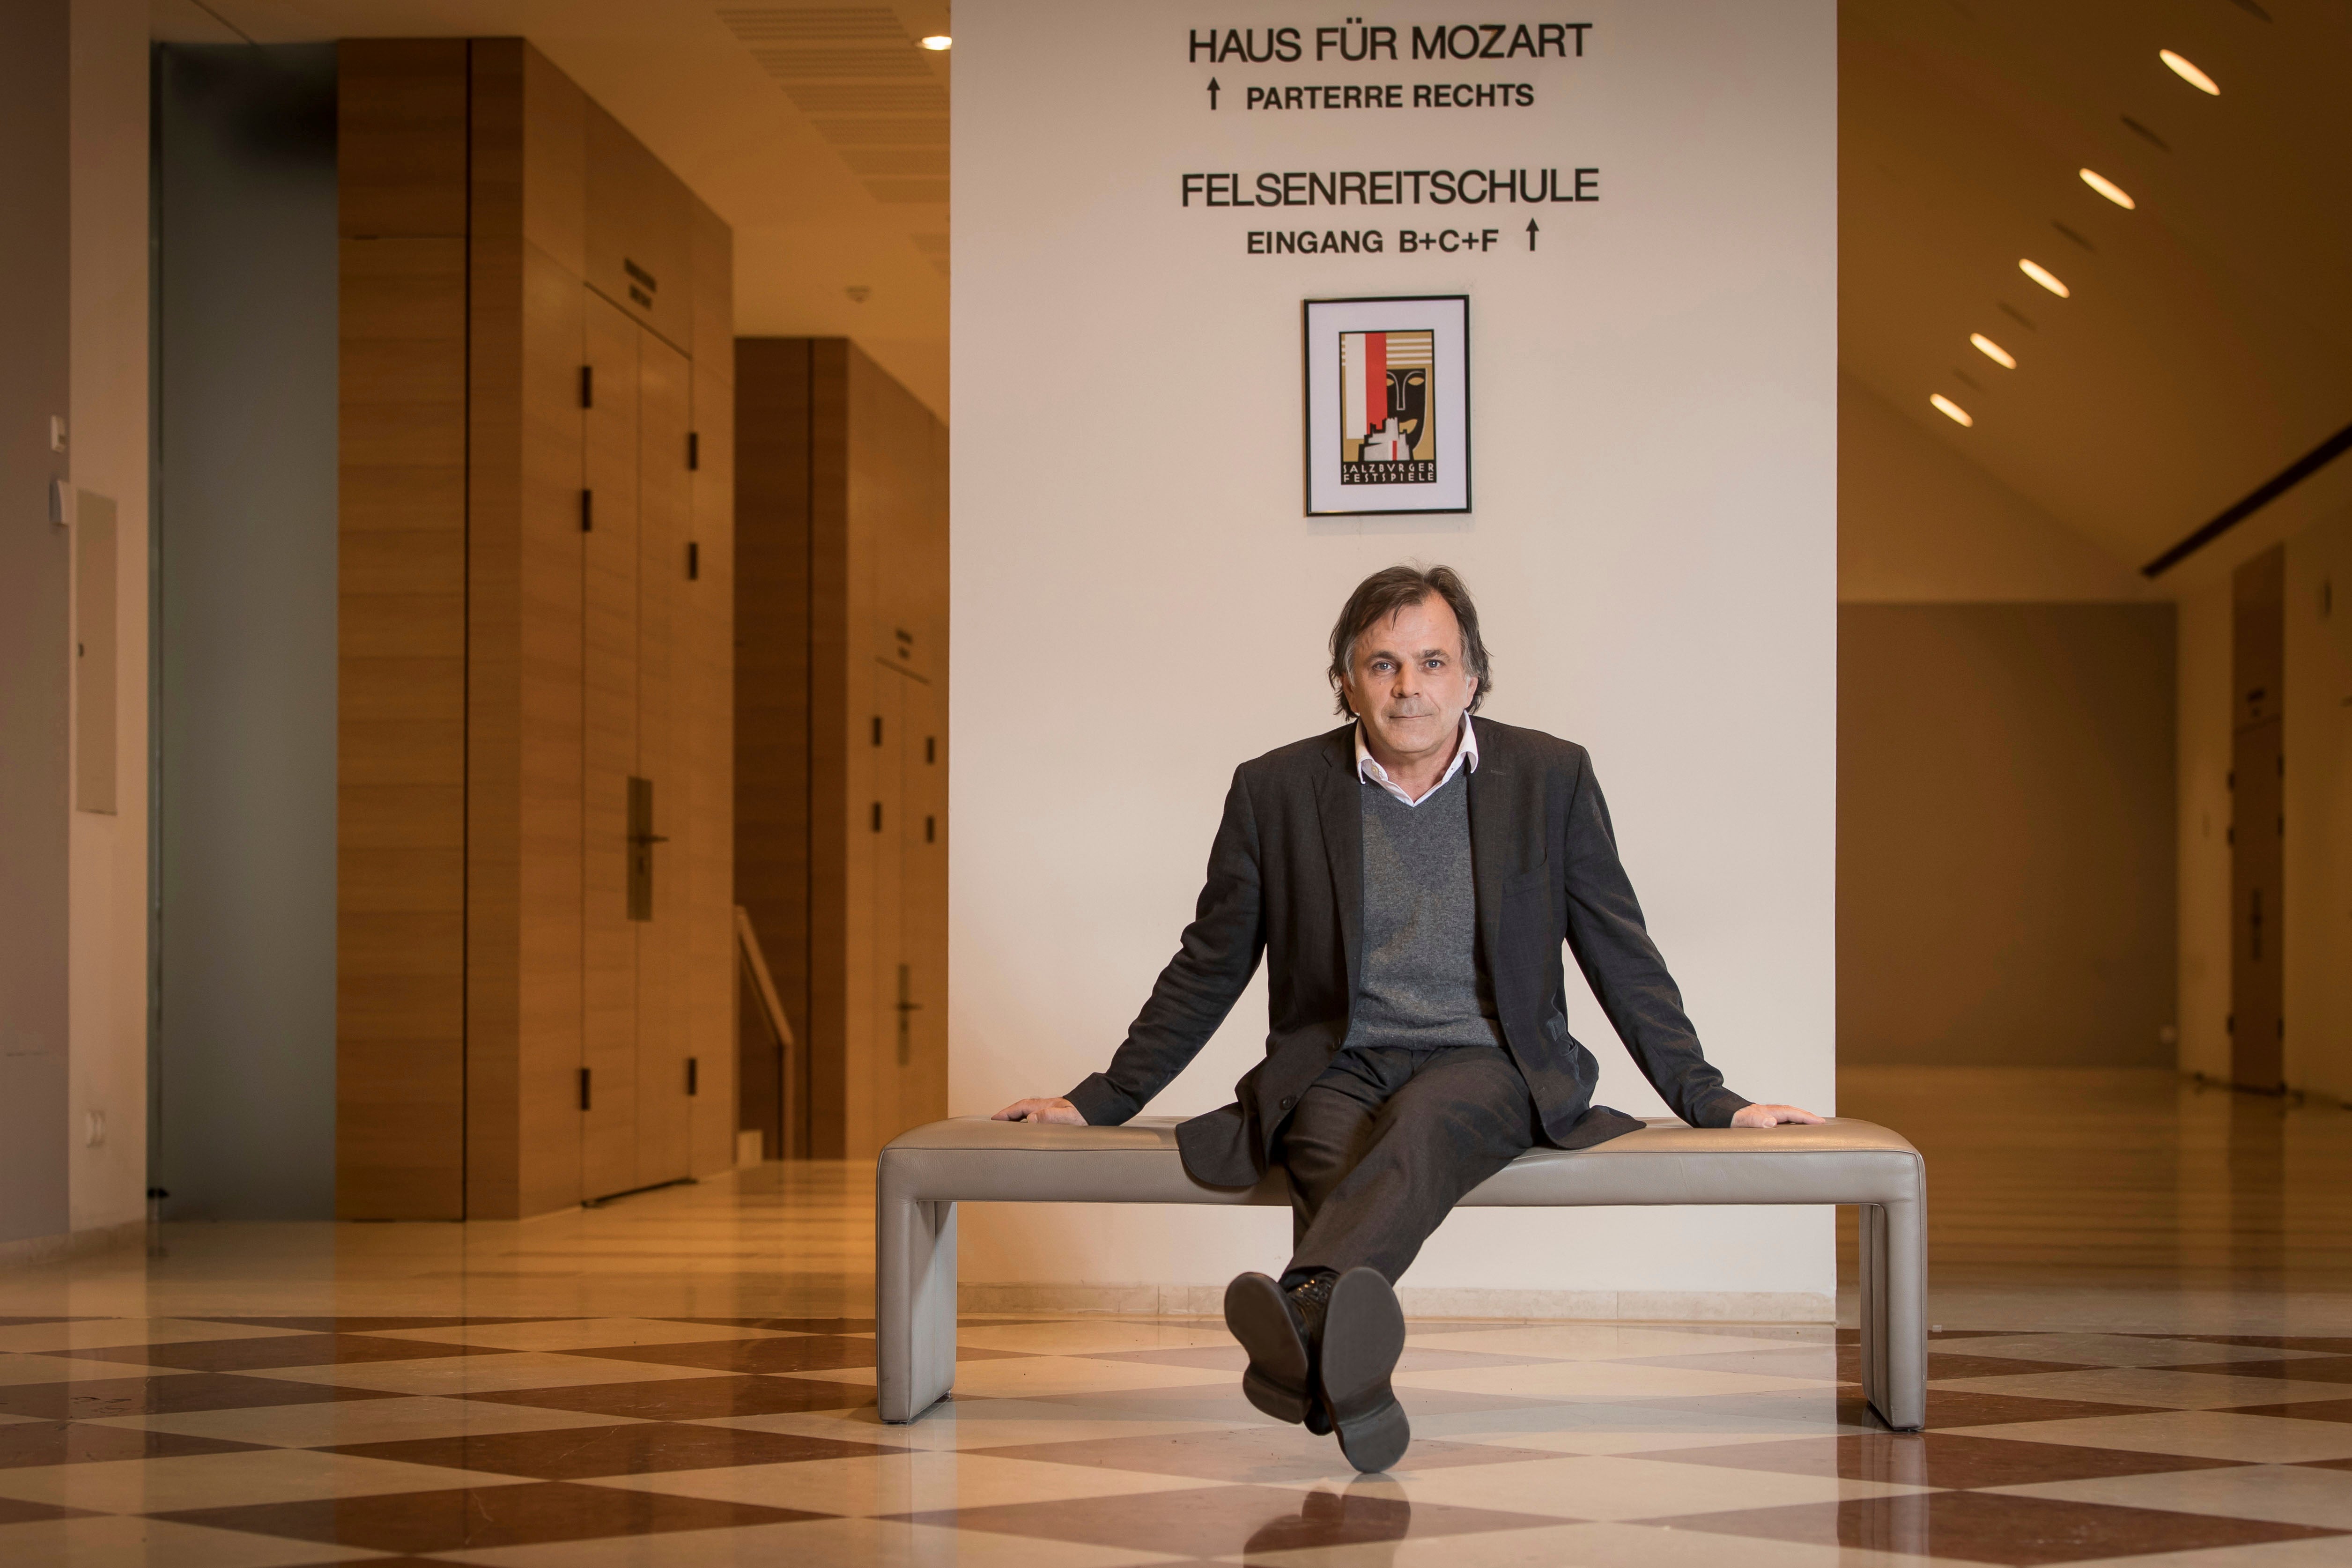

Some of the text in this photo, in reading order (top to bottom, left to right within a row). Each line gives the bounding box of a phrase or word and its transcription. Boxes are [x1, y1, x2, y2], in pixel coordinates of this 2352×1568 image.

[1189, 17, 1593, 63] HAUS FÜR MOZART
[1247, 83, 1534, 110] PARTERRE RECHTS
[1182, 168, 1599, 207] FELSENREITSCHULE
[1248, 229, 1499, 254] EINGANG B+C+F
[1343, 472, 1434, 482] FESTSPIELE
